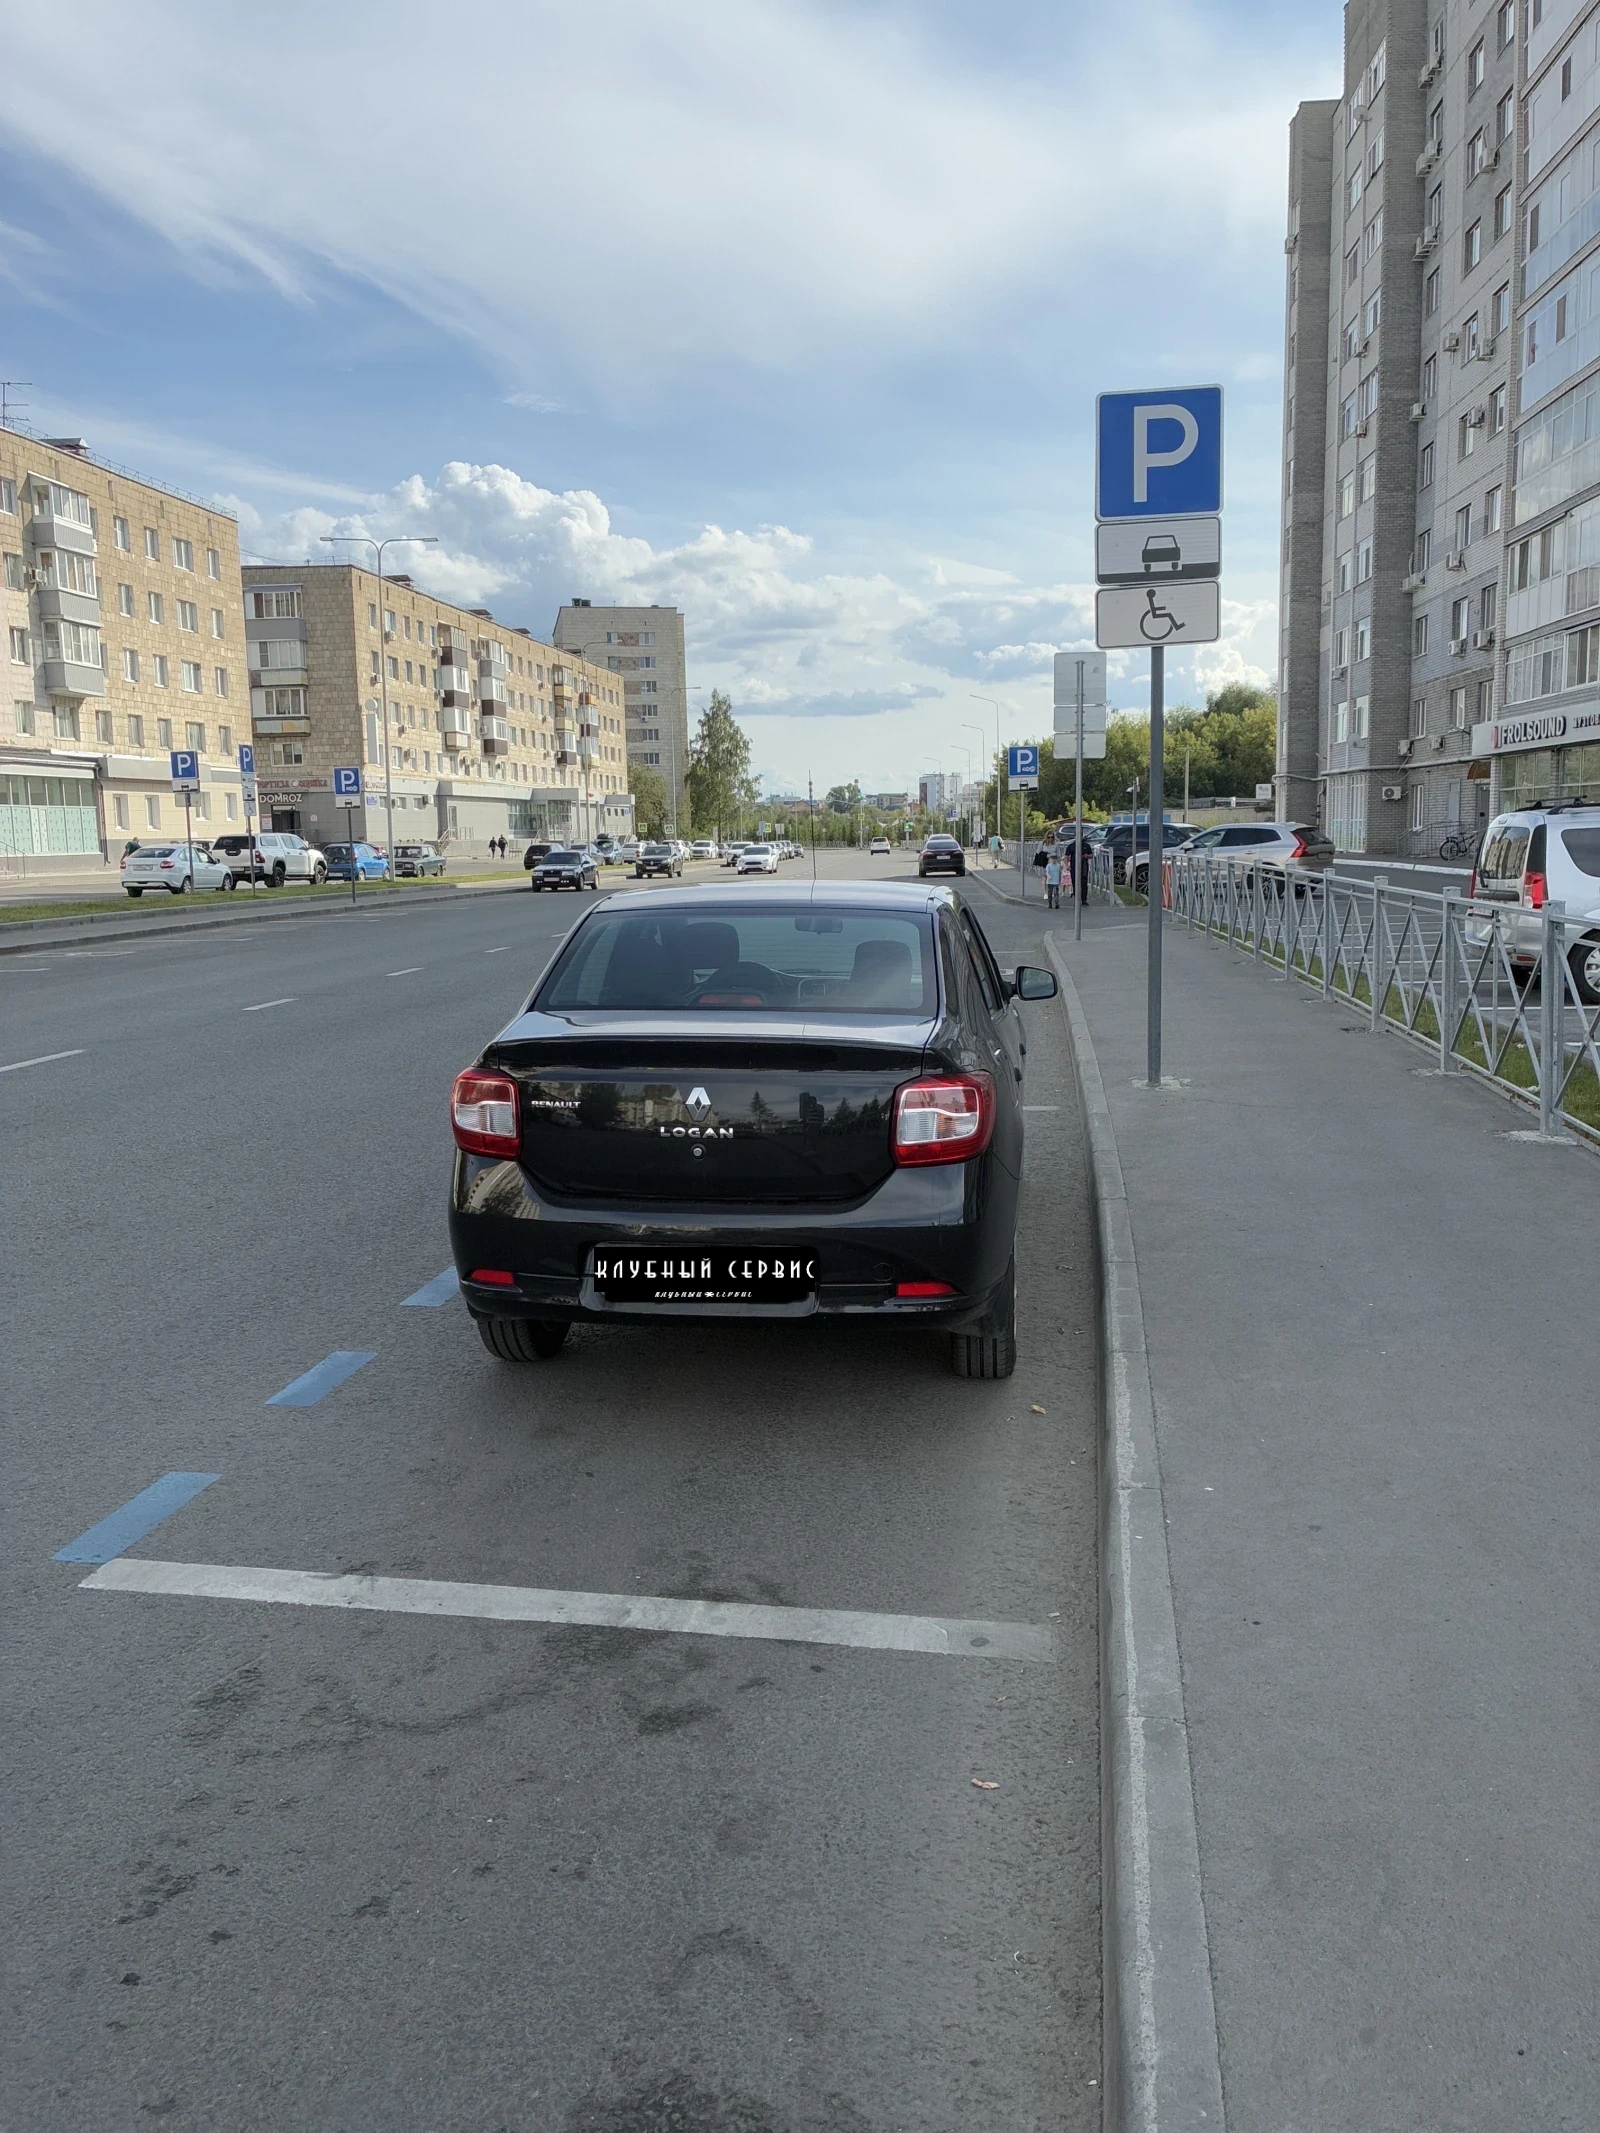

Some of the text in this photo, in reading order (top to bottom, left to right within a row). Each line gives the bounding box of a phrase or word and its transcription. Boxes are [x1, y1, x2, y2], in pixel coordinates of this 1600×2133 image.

[1133, 403, 1199, 503] P
[1502, 716, 1566, 744] FROLSOUND
[177, 754, 191, 776] P
[243, 747, 251, 769] P
[1017, 750, 1033, 773] P
[340, 770, 355, 792] P
[260, 794, 302, 803] DOMROZ
[531, 1101, 581, 1109] RENAULT
[660, 1126, 734, 1139] LOGAN
